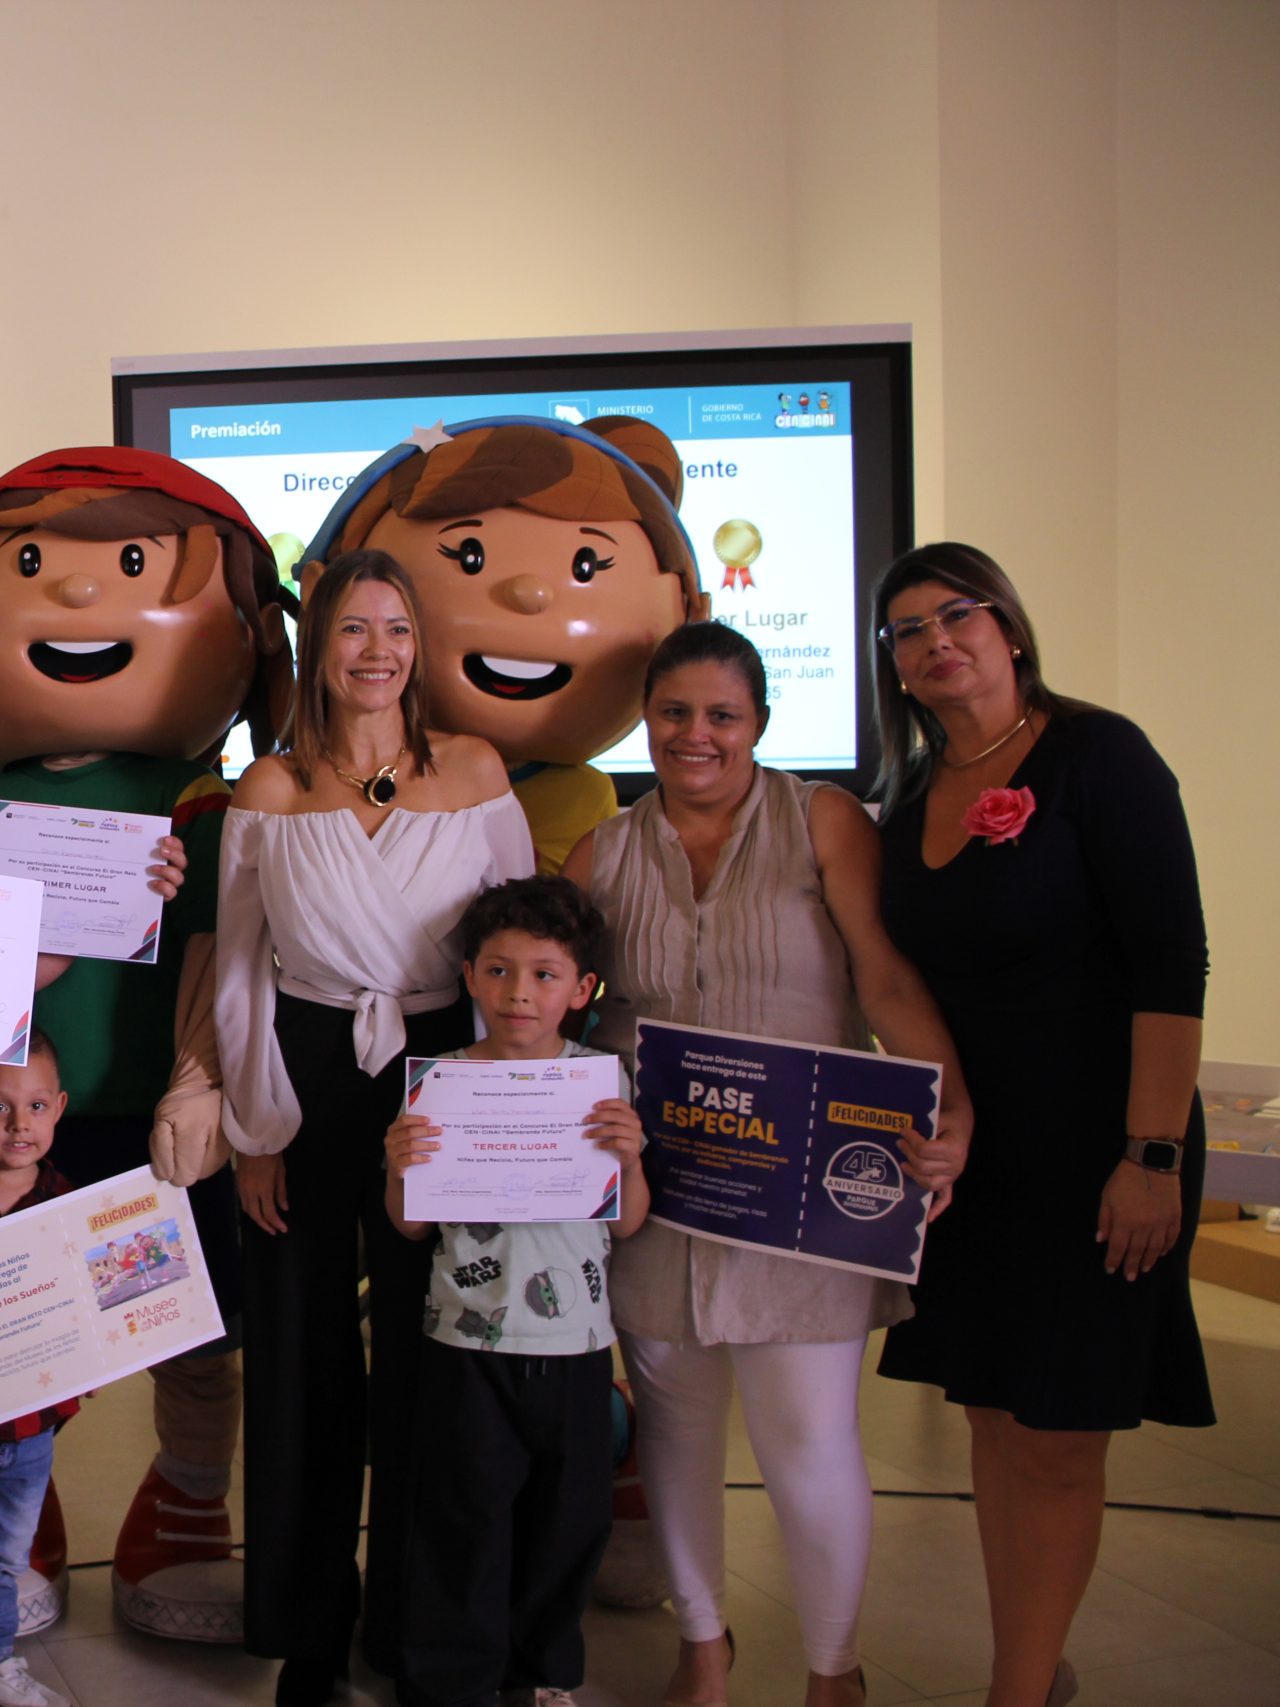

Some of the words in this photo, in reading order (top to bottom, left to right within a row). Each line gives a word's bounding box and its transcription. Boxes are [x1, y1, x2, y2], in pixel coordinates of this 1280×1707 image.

[597, 405, 654, 416] MINISTERIO
[702, 403, 744, 413] GOBIERNO
[702, 414, 712, 423] DE
[715, 413, 741, 422] COSTA
[743, 412, 762, 421] RICA
[191, 420, 281, 439] Premiación
[745, 610, 808, 631] Lugar
[764, 666, 791, 680] San
[797, 665, 834, 680] Juan
[74, 884, 106, 892] LUGAR
[685, 1050, 714, 1062] Parque
[715, 1055, 764, 1070] Diversiones
[681, 1060, 701, 1070] hace
[702, 1065, 735, 1077] entrega
[736, 1069, 746, 1078] de
[748, 1073, 767, 1081] este
[688, 1081, 754, 1115] PASE
[663, 1101, 779, 1145] ESPECIAL
[832, 1105, 909, 1128] ¡FELICIDADES!
[842, 1150, 887, 1183] 45
[827, 1179, 901, 1199] ANIVERSARIO
[91, 1196, 155, 1231] ¡FELICIDADES!
[7, 1252, 30, 1265] Niños
[17, 1263, 28, 1271] de
[452, 1255, 499, 1279] STAR
[454, 1265, 502, 1289] WARS
[3, 1295, 18, 1306] los
[136, 1297, 177, 1319] Museo
[148, 1309, 180, 1329] Niños
